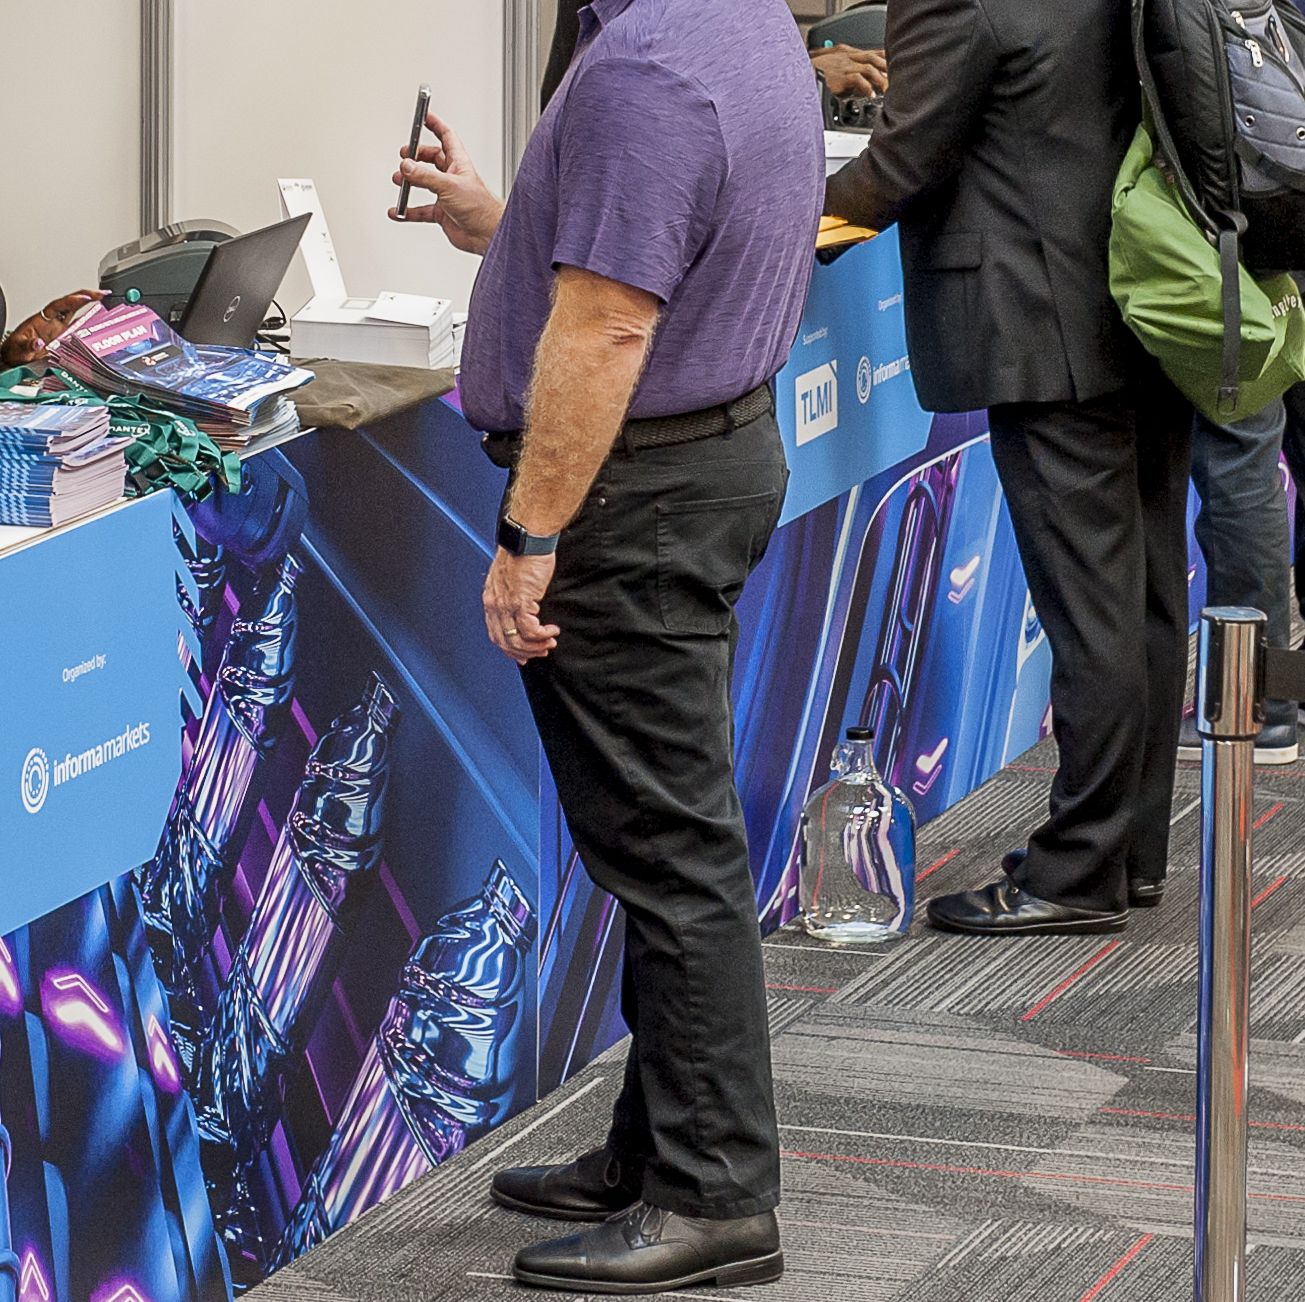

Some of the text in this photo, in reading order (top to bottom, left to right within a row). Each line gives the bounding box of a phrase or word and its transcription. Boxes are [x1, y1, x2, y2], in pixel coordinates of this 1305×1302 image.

[91, 324, 149, 352] FLOOR PLAN
[801, 379, 833, 426] TLMI
[62, 653, 107, 683] Organized by:
